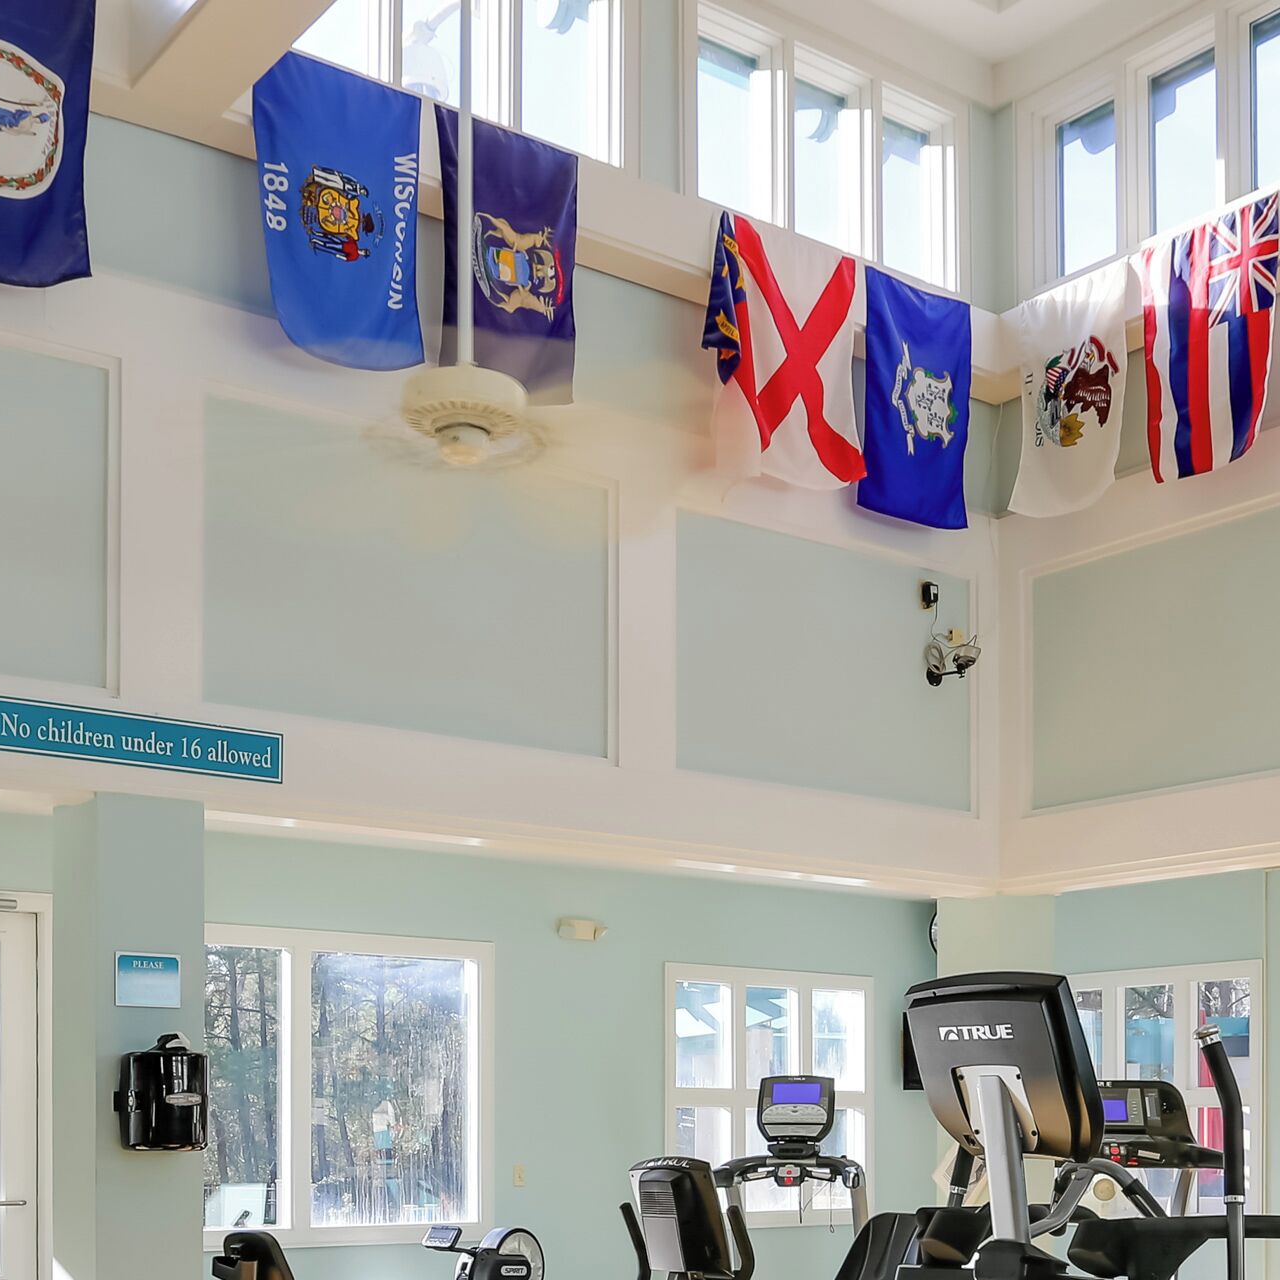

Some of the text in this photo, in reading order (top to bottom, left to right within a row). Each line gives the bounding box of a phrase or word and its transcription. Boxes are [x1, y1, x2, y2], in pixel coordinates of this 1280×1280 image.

[263, 161, 289, 231] 1848
[387, 153, 417, 310] WISCONSIN
[0, 712, 271, 768] No children under 16 allowed
[132, 960, 165, 969] PLEASE
[957, 1024, 1014, 1040] TRUE
